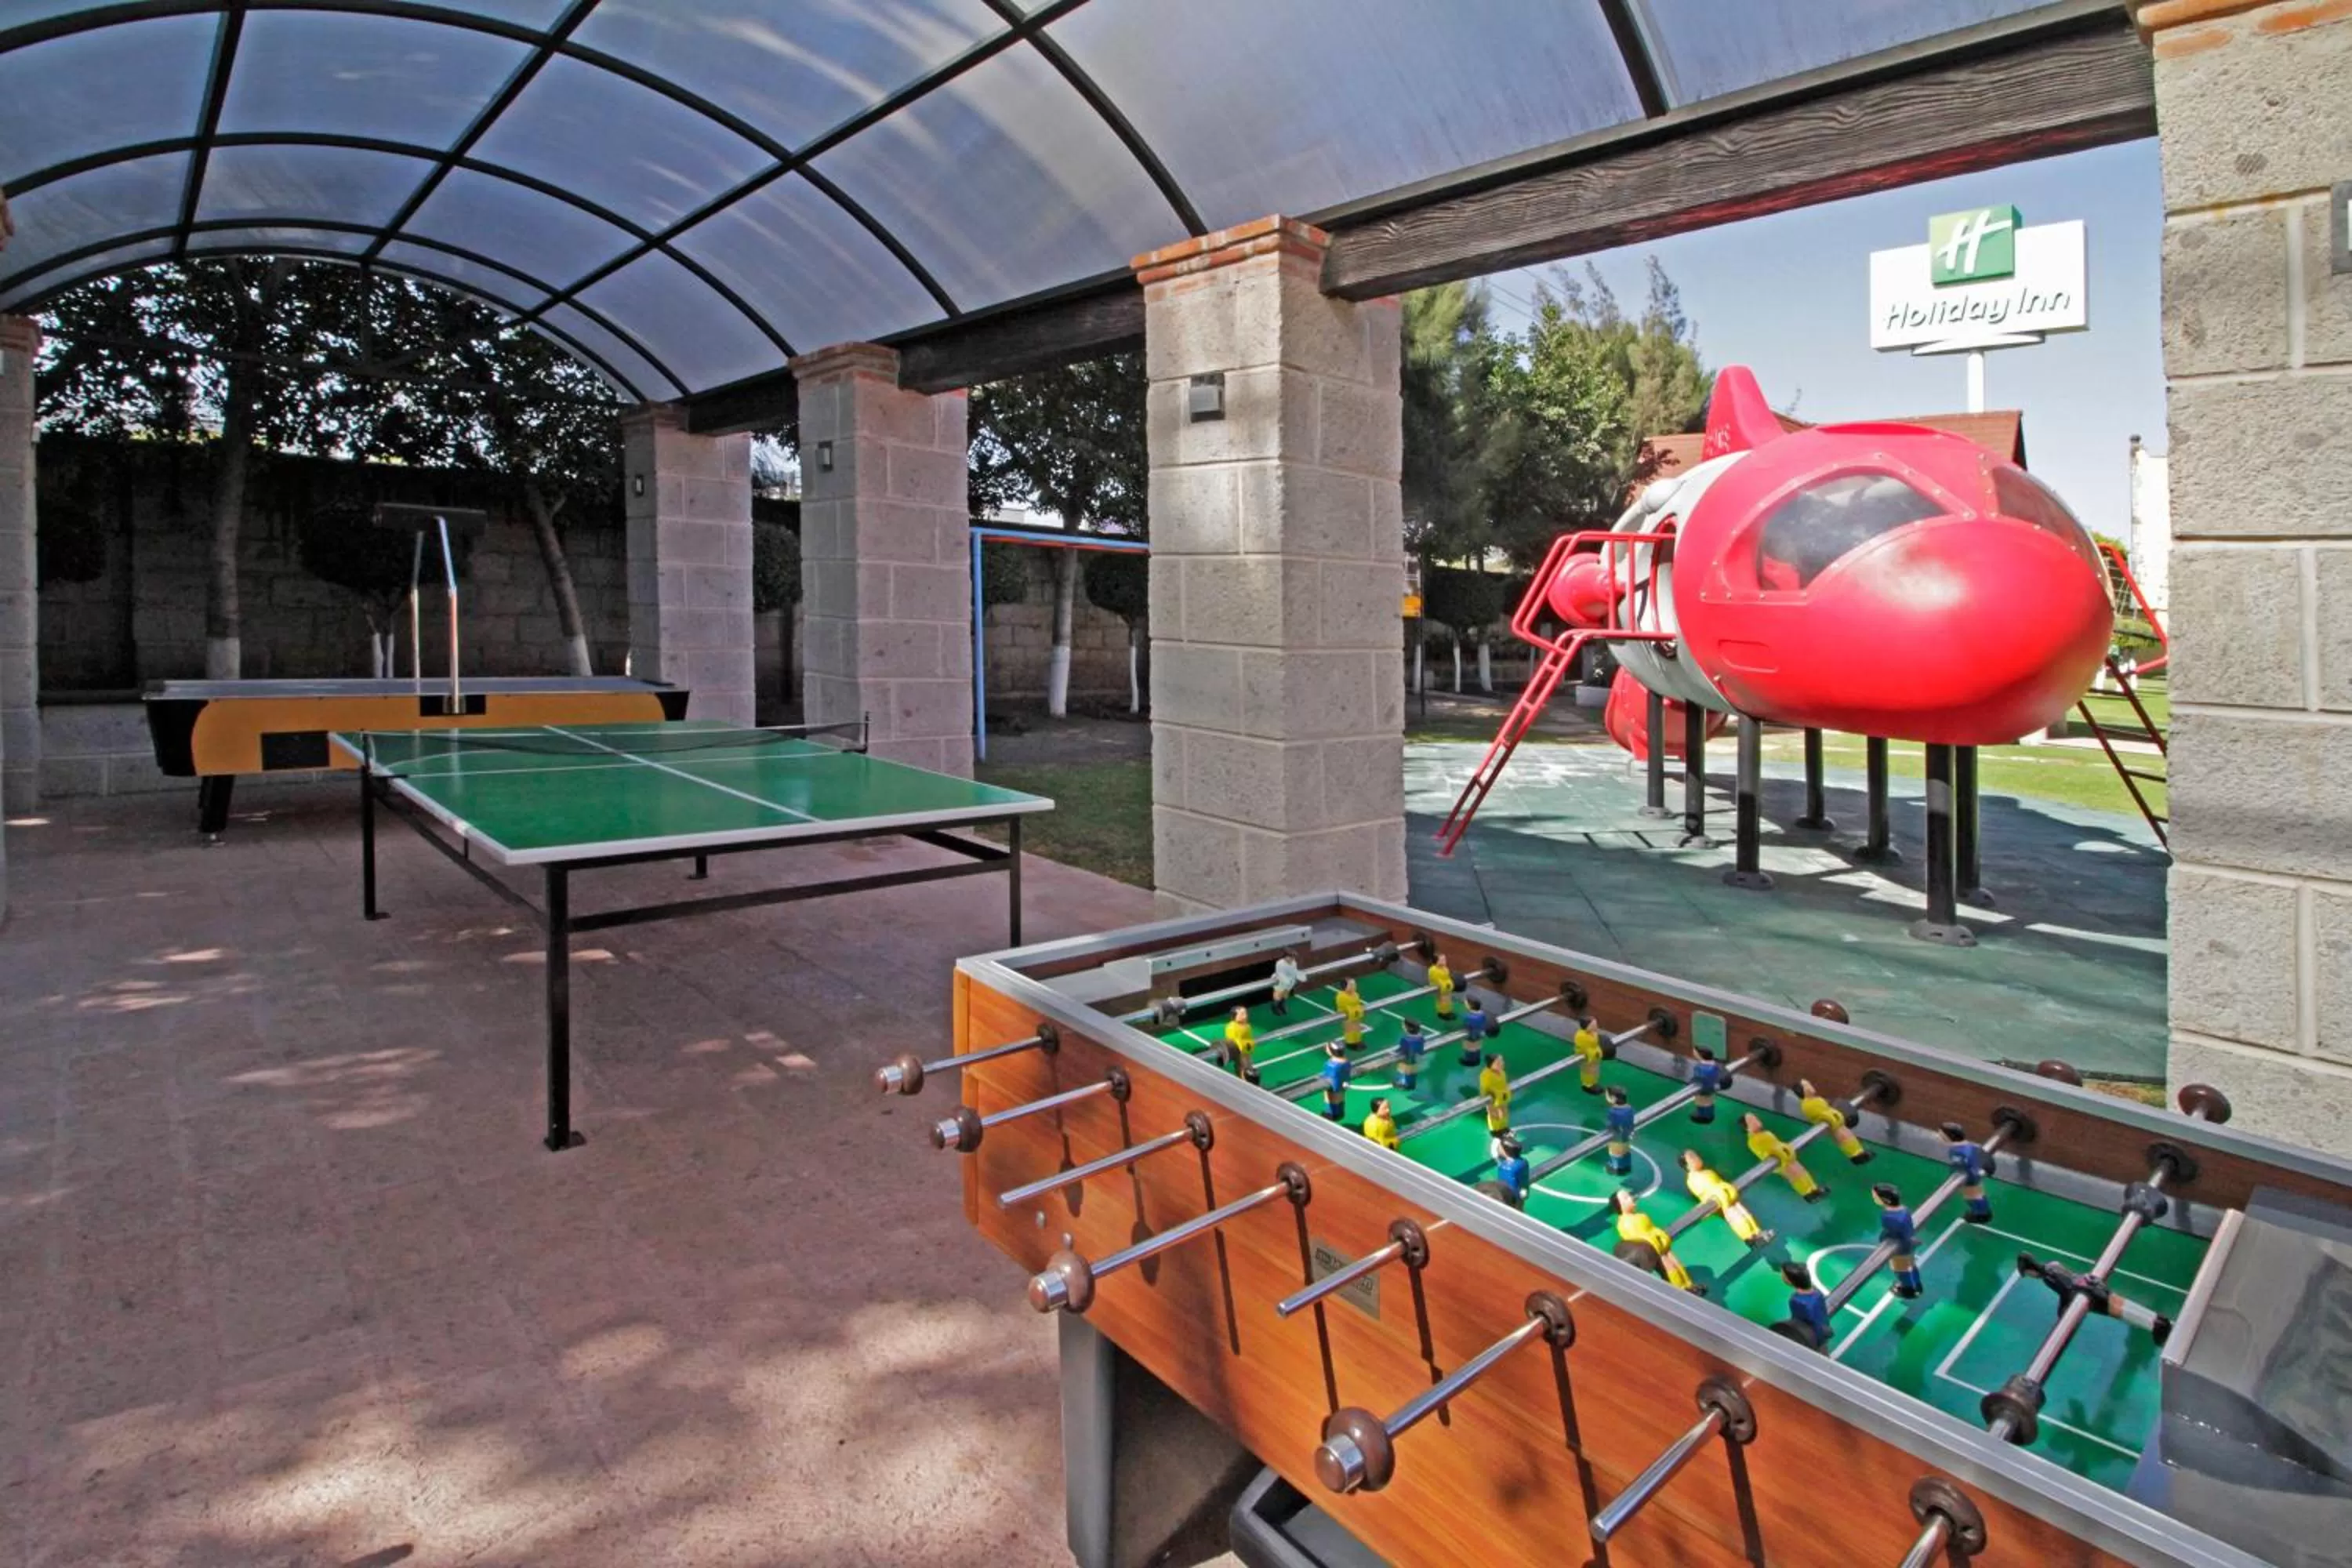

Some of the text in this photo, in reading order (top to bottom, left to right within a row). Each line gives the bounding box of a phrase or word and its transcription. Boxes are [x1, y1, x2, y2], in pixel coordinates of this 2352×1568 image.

[1936, 209, 2013, 274] H
[1885, 288, 2071, 330] Holiday Inn
